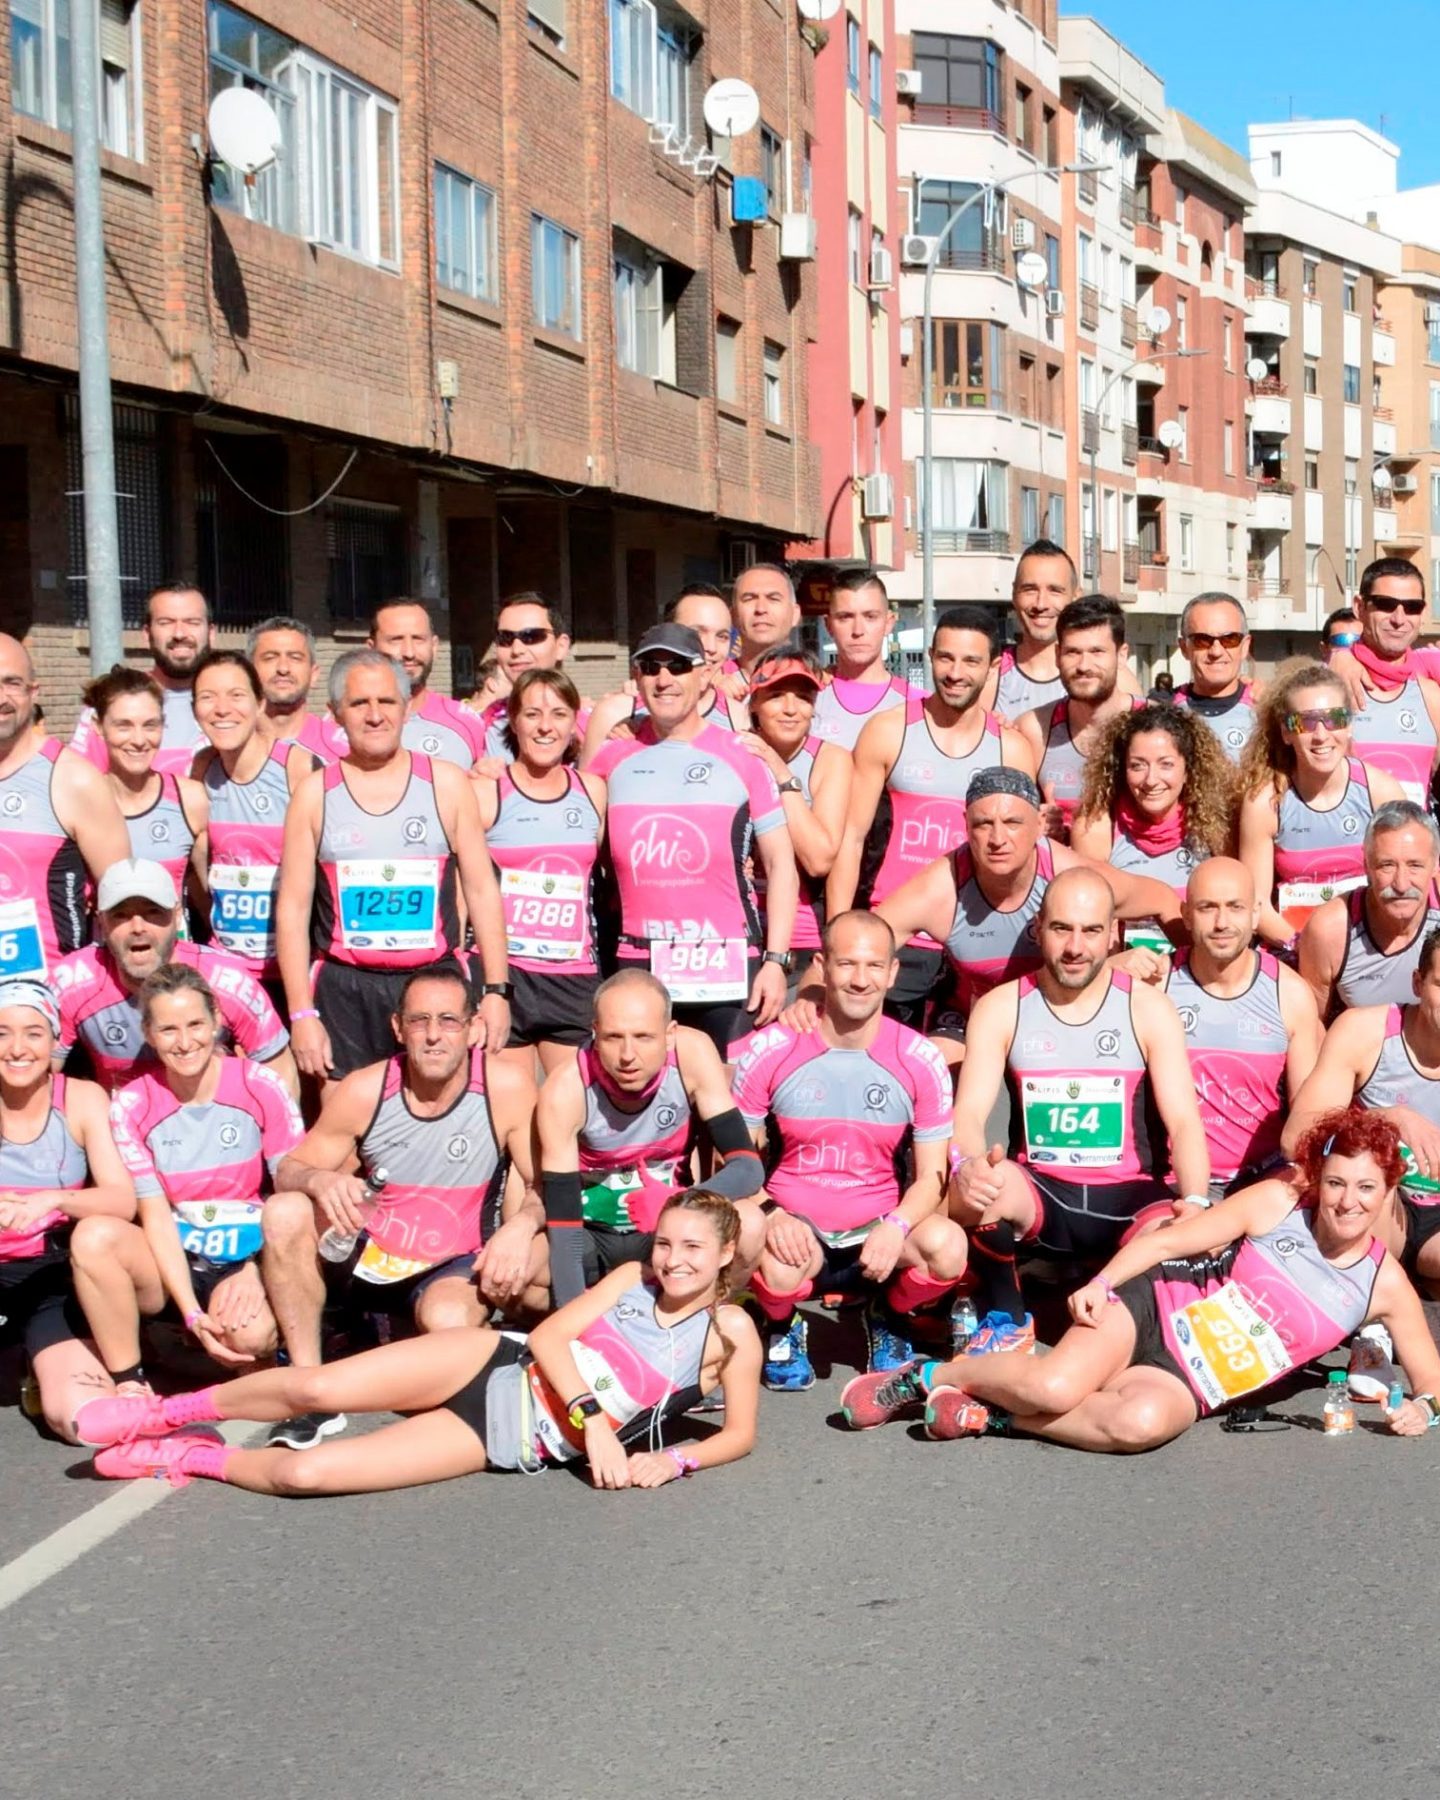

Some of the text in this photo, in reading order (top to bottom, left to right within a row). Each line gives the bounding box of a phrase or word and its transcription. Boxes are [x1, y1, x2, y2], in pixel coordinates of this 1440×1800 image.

[221, 893, 271, 920] 690
[354, 890, 423, 917] 1259
[512, 899, 577, 928] 1388
[669, 946, 728, 972] 984
[1047, 1106, 1101, 1134] 164
[184, 1228, 240, 1257] 681
[1207, 1318, 1256, 1372] 993
